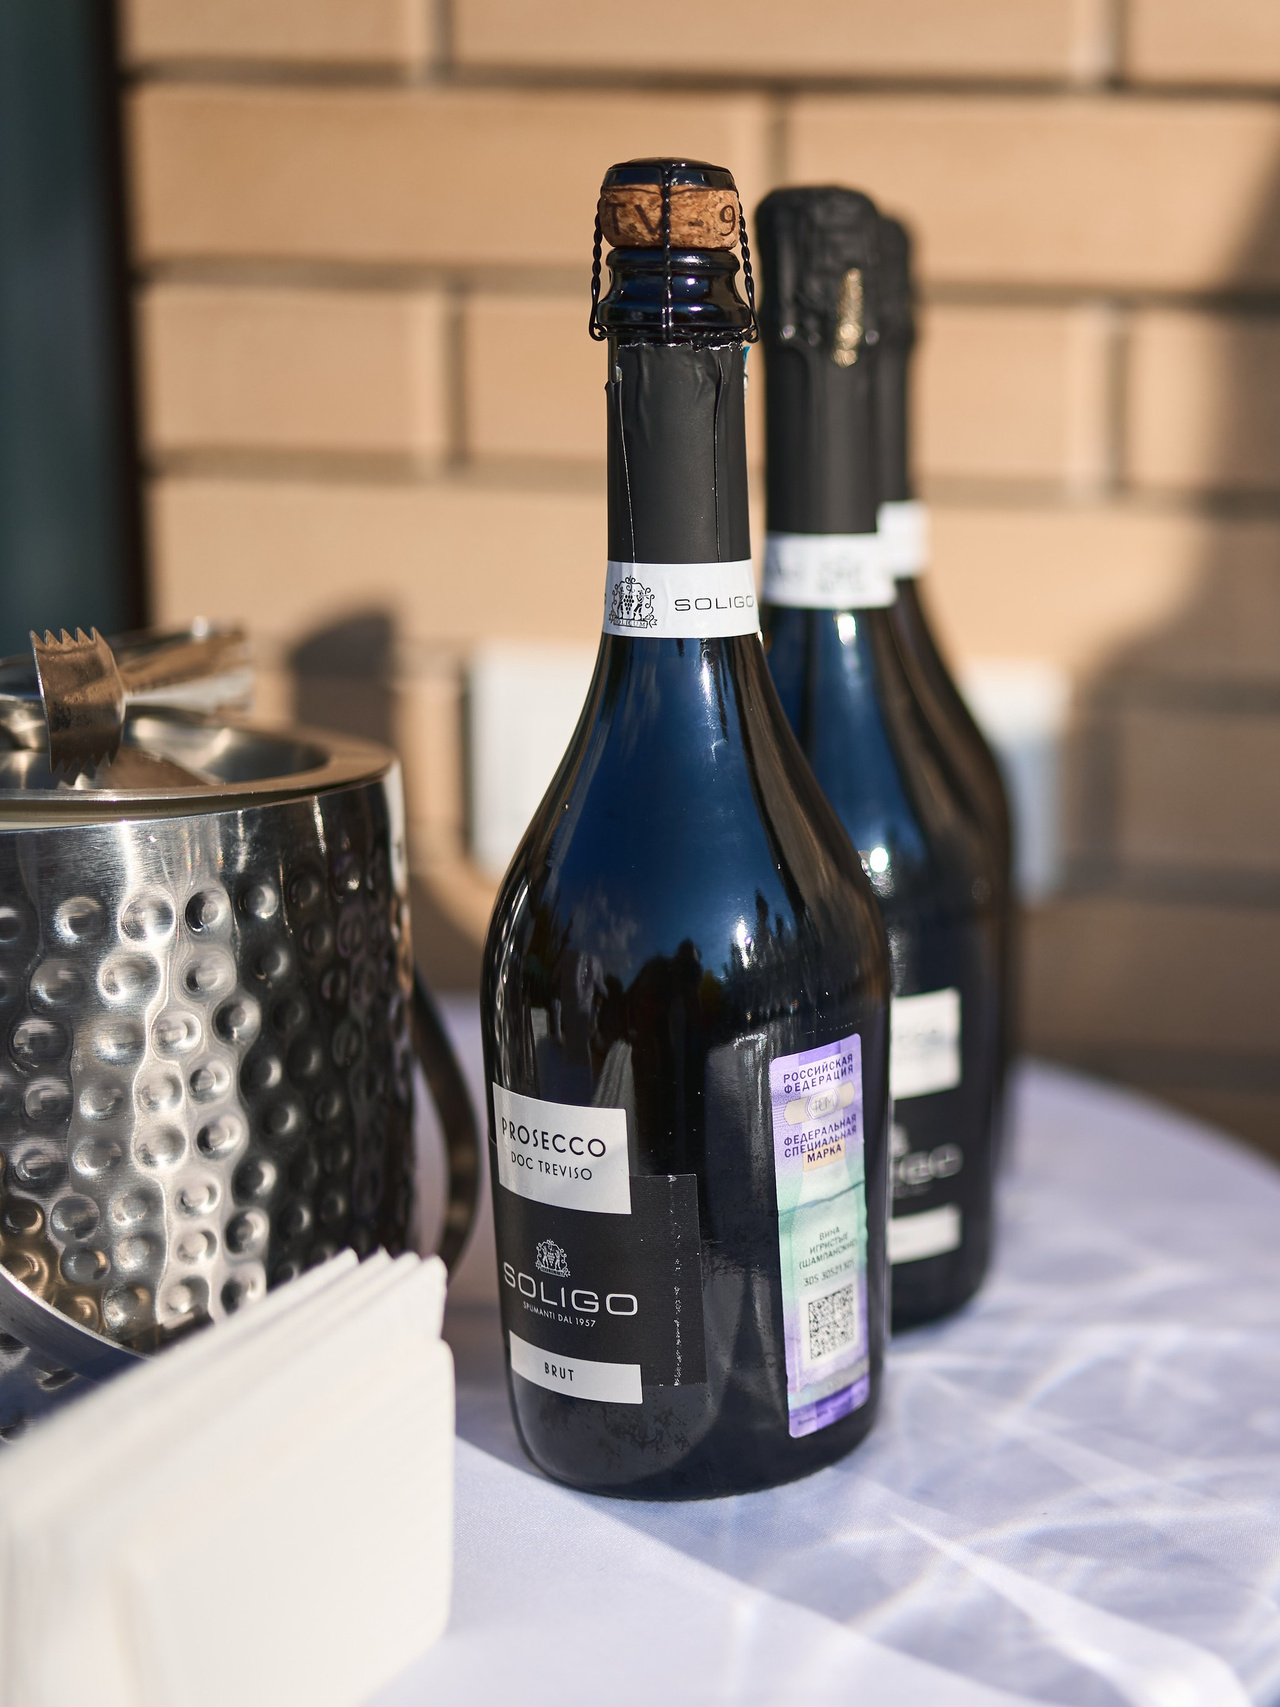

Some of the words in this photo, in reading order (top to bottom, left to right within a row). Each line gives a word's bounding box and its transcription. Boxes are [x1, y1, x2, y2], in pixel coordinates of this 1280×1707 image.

[674, 595, 755, 612] SOLIGO
[783, 1053, 853, 1083] РОССИЙСКАЯ
[784, 1064, 854, 1094] ФЕДЕРАЦИЯ
[501, 1117, 606, 1157] PROSECCO
[784, 1113, 857, 1147] ФЕДЕРАЛЬНАЯ
[784, 1125, 857, 1158] СПЕЦИАЛЬНАЯ
[511, 1151, 534, 1170] DOC
[538, 1160, 593, 1181] TREVISO
[807, 1144, 842, 1163] МАРКА
[503, 1262, 639, 1316] SOLIGO
[523, 1301, 555, 1320] SPUMANTI
[557, 1313, 573, 1325] DAL
[575, 1317, 596, 1328] 1957
[544, 1362, 574, 1382] BRUT
